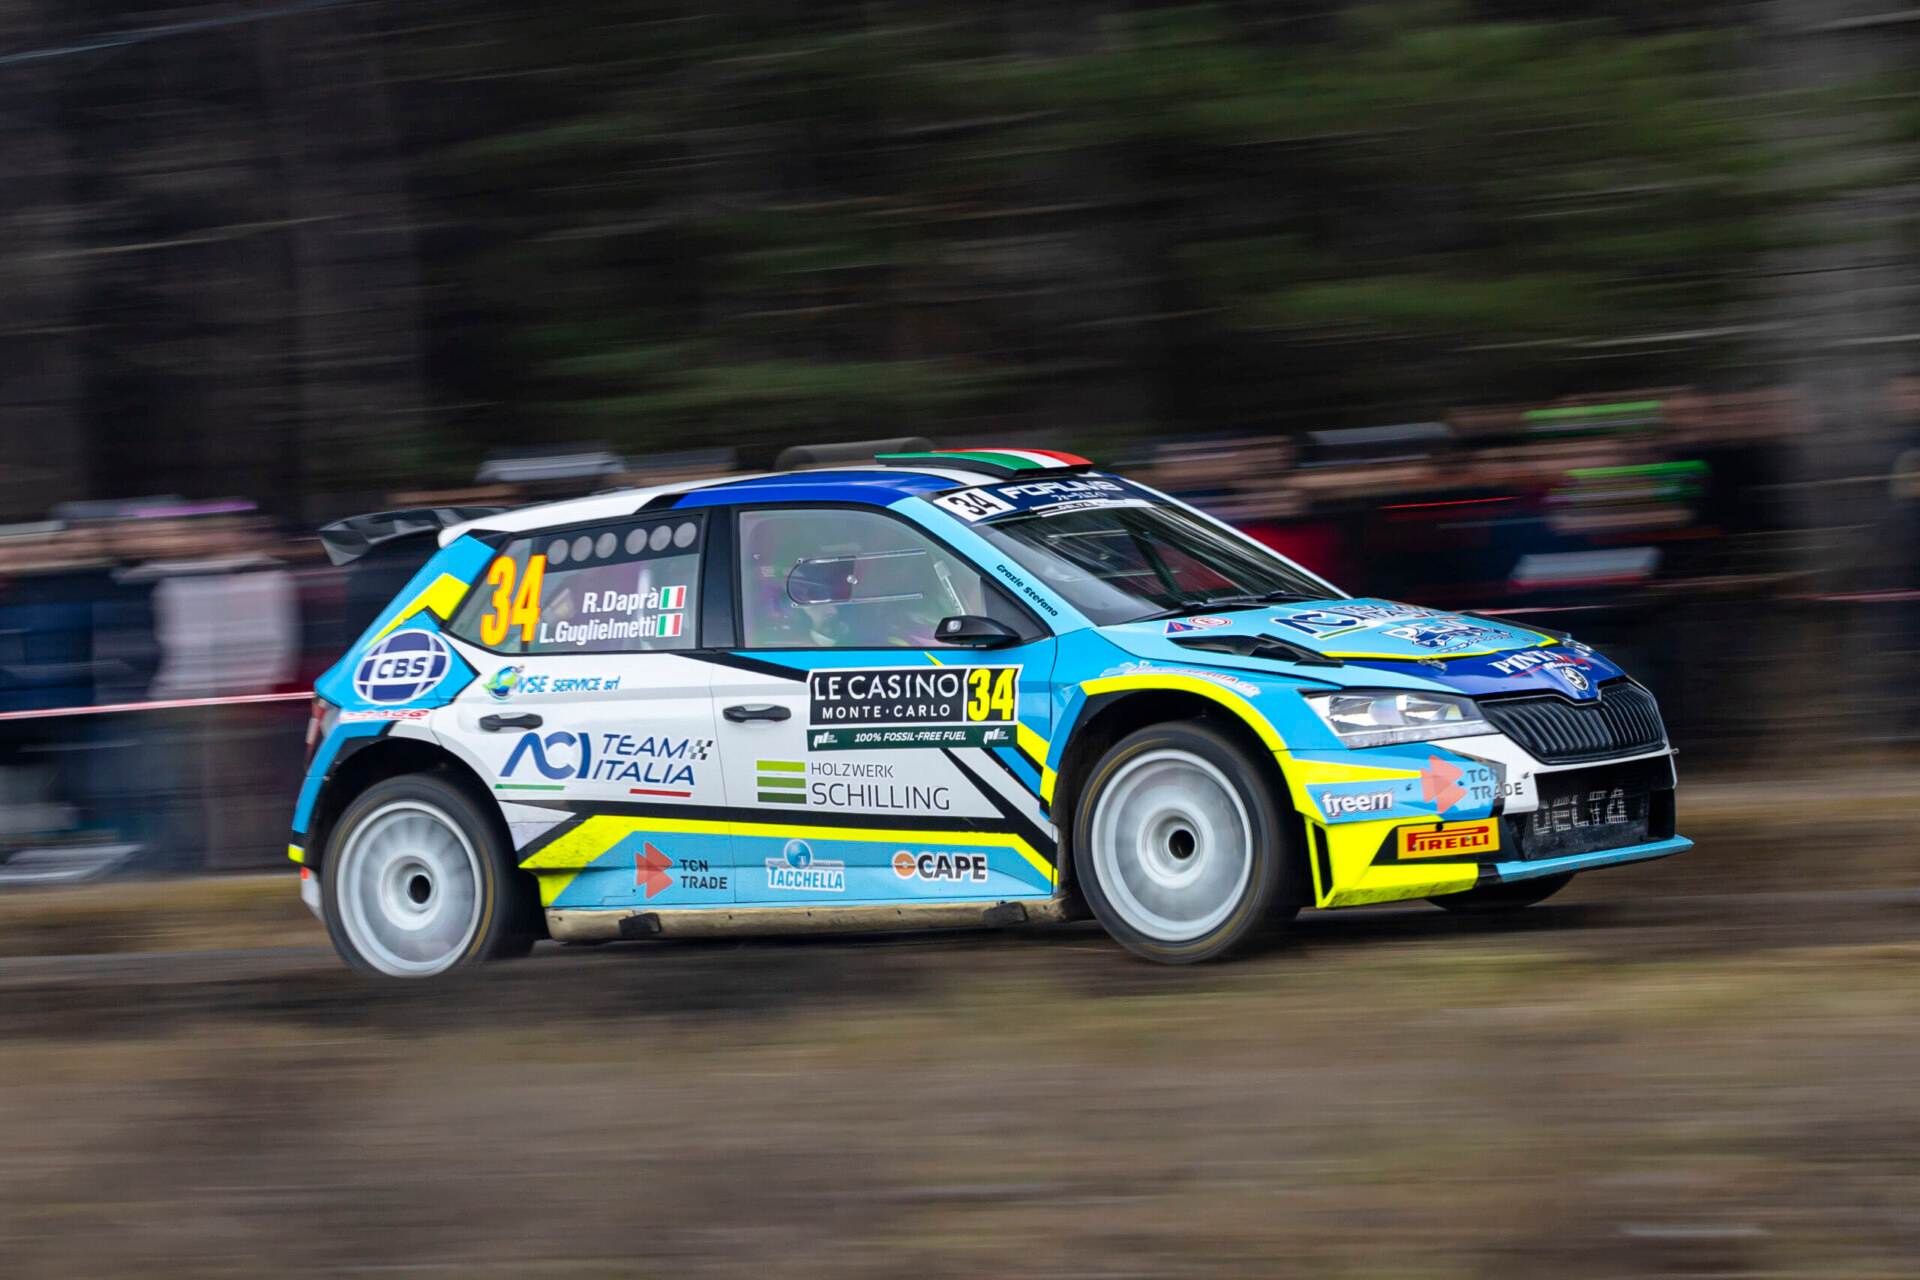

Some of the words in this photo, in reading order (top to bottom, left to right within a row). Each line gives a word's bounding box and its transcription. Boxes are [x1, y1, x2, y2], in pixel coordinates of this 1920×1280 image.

[948, 492, 1003, 516] 34
[480, 553, 548, 647] 34
[582, 587, 659, 615] R.Daprà
[996, 564, 1024, 587] Grazie
[1023, 587, 1058, 616] Stefano
[377, 656, 428, 679] CBS
[551, 677, 602, 692] SERVICE
[814, 676, 842, 700] LE
[848, 673, 959, 699] CASINO
[967, 668, 1016, 722] 34
[602, 733, 689, 759] TEAM
[854, 732, 882, 743] 100%
[883, 731, 942, 742] FOSSIL-FREE
[943, 731, 967, 741] FUEL
[499, 731, 591, 780] ACI
[592, 759, 695, 786] ITALIA
[811, 762, 894, 778] HOLZWERK
[811, 782, 950, 810] SCHILLING
[1407, 826, 1489, 851] PIRELLI
[680, 859, 709, 872] TCN
[769, 866, 843, 889] TACCHELLA
[917, 854, 986, 880] CAPE
[680, 876, 728, 889] TRADE
